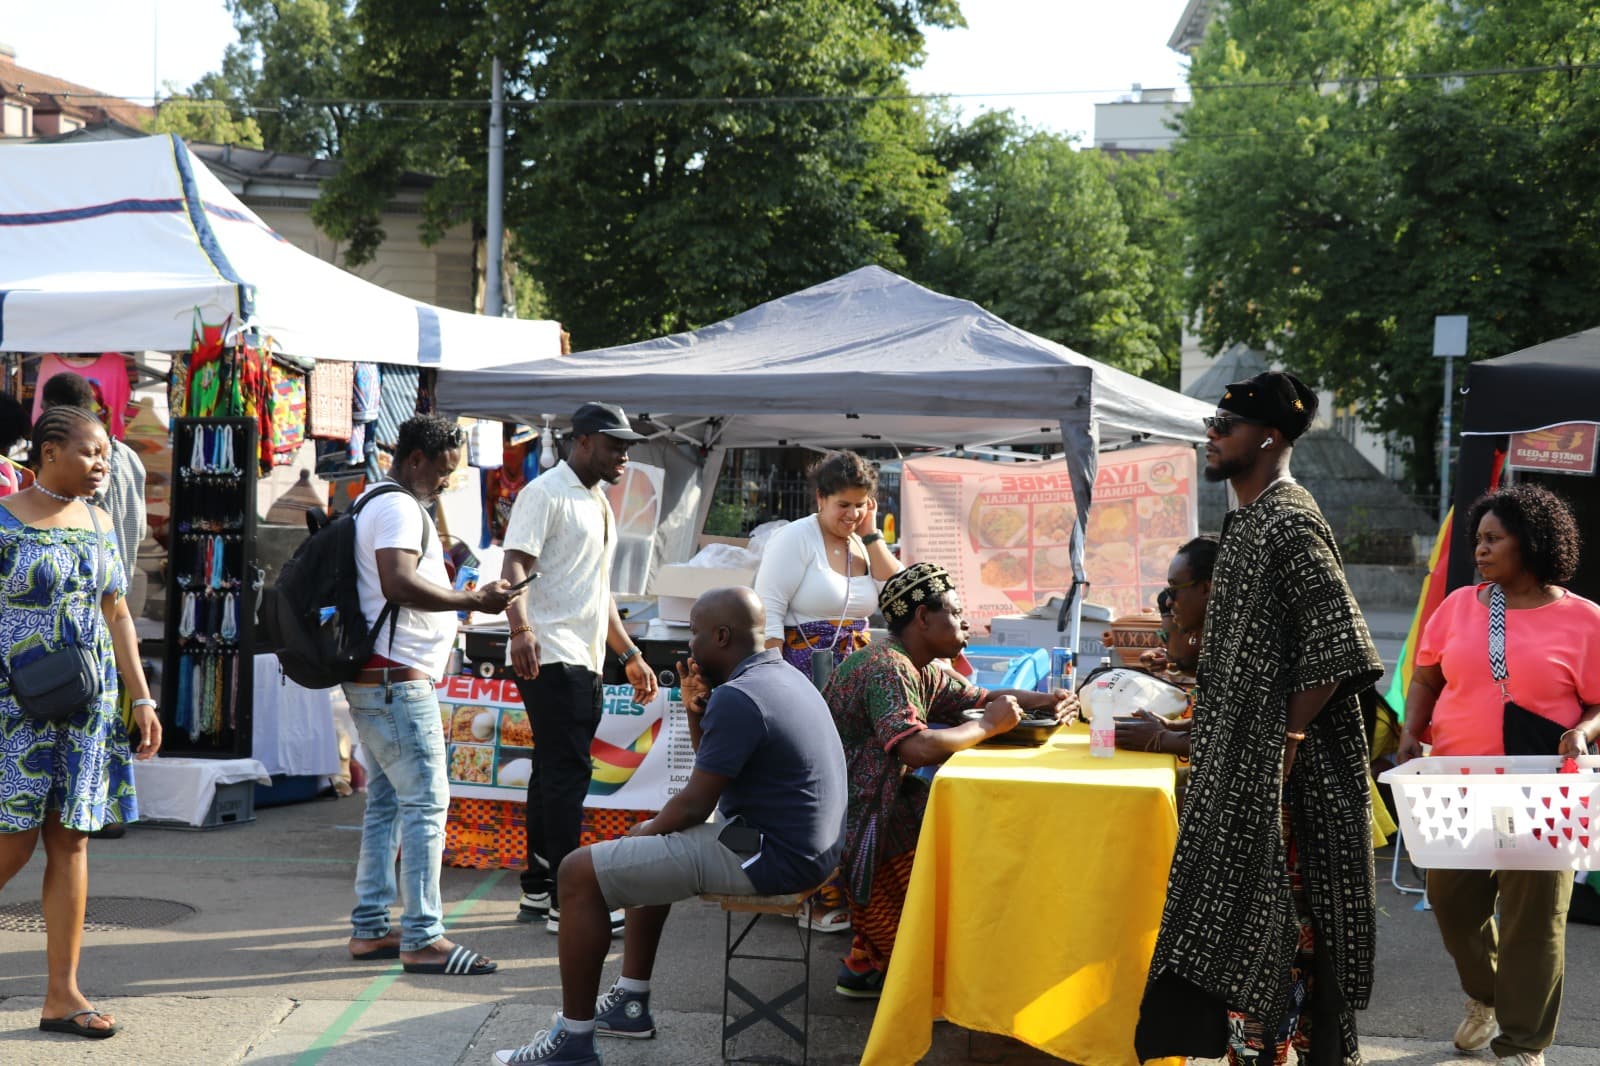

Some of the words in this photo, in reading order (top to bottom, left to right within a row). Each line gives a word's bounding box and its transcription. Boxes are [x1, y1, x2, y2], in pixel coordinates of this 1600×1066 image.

[1551, 452, 1585, 461] STAND
[435, 676, 524, 703] EMB
[602, 685, 635, 696] ARI
[602, 699, 645, 716] HES
